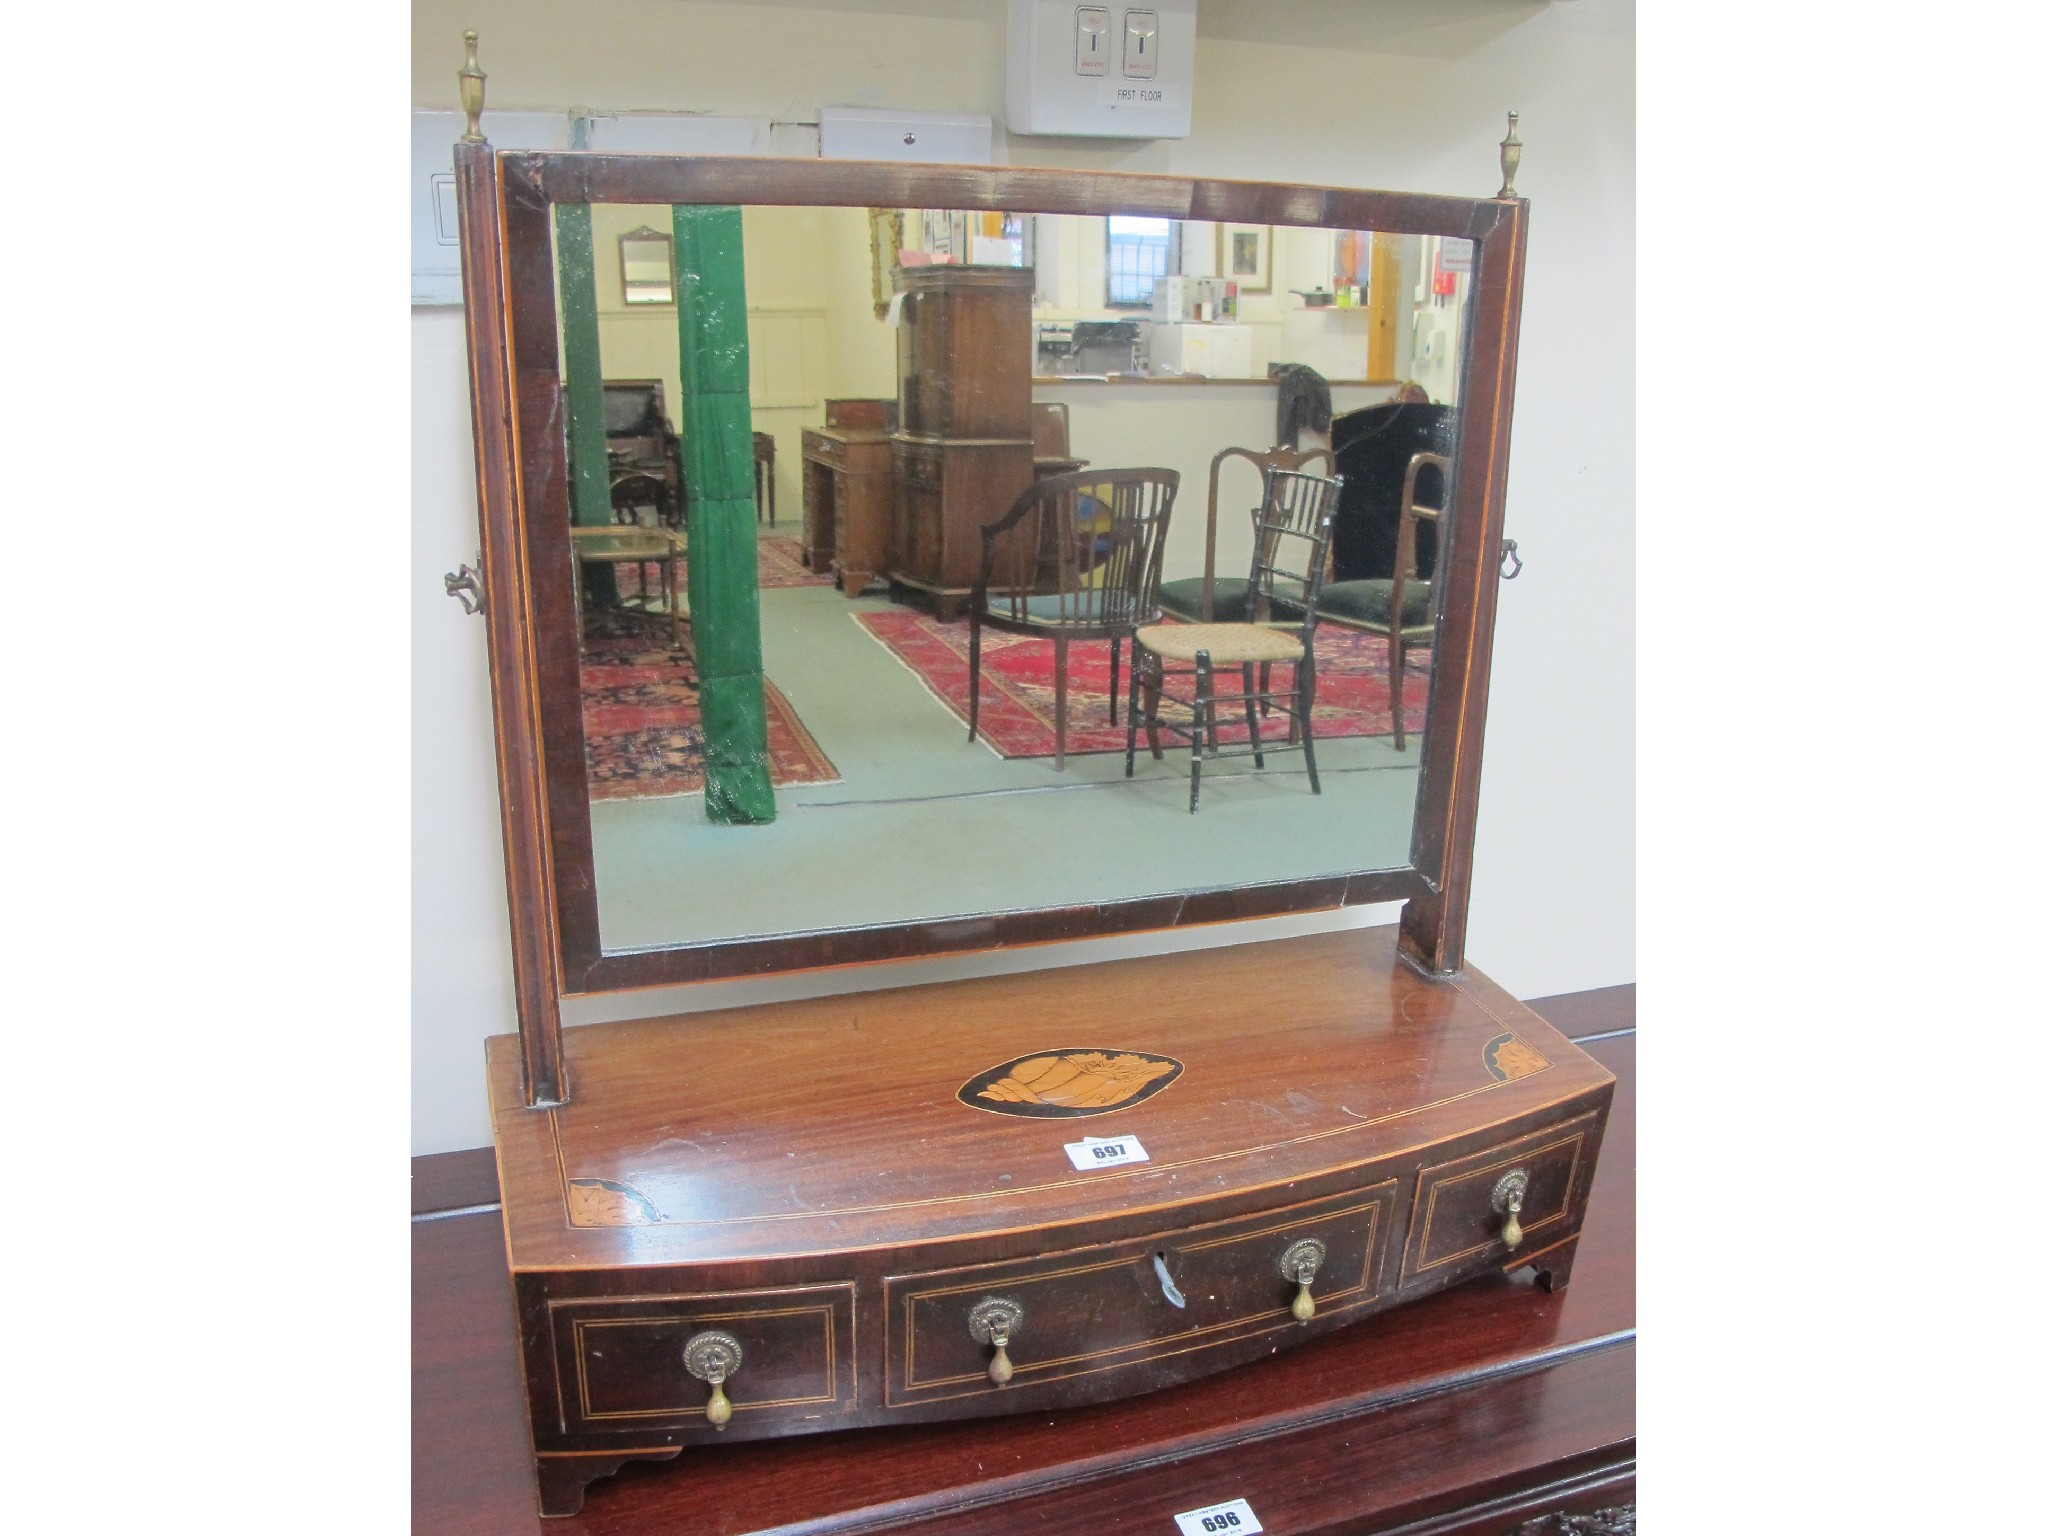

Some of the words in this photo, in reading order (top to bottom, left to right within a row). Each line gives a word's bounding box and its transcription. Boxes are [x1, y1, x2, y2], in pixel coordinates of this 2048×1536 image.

[1117, 89, 1136, 100] FIRST
[1140, 90, 1162, 102] FLOOR
[1092, 1144, 1126, 1159] 697
[1201, 1511, 1241, 1532] 696
